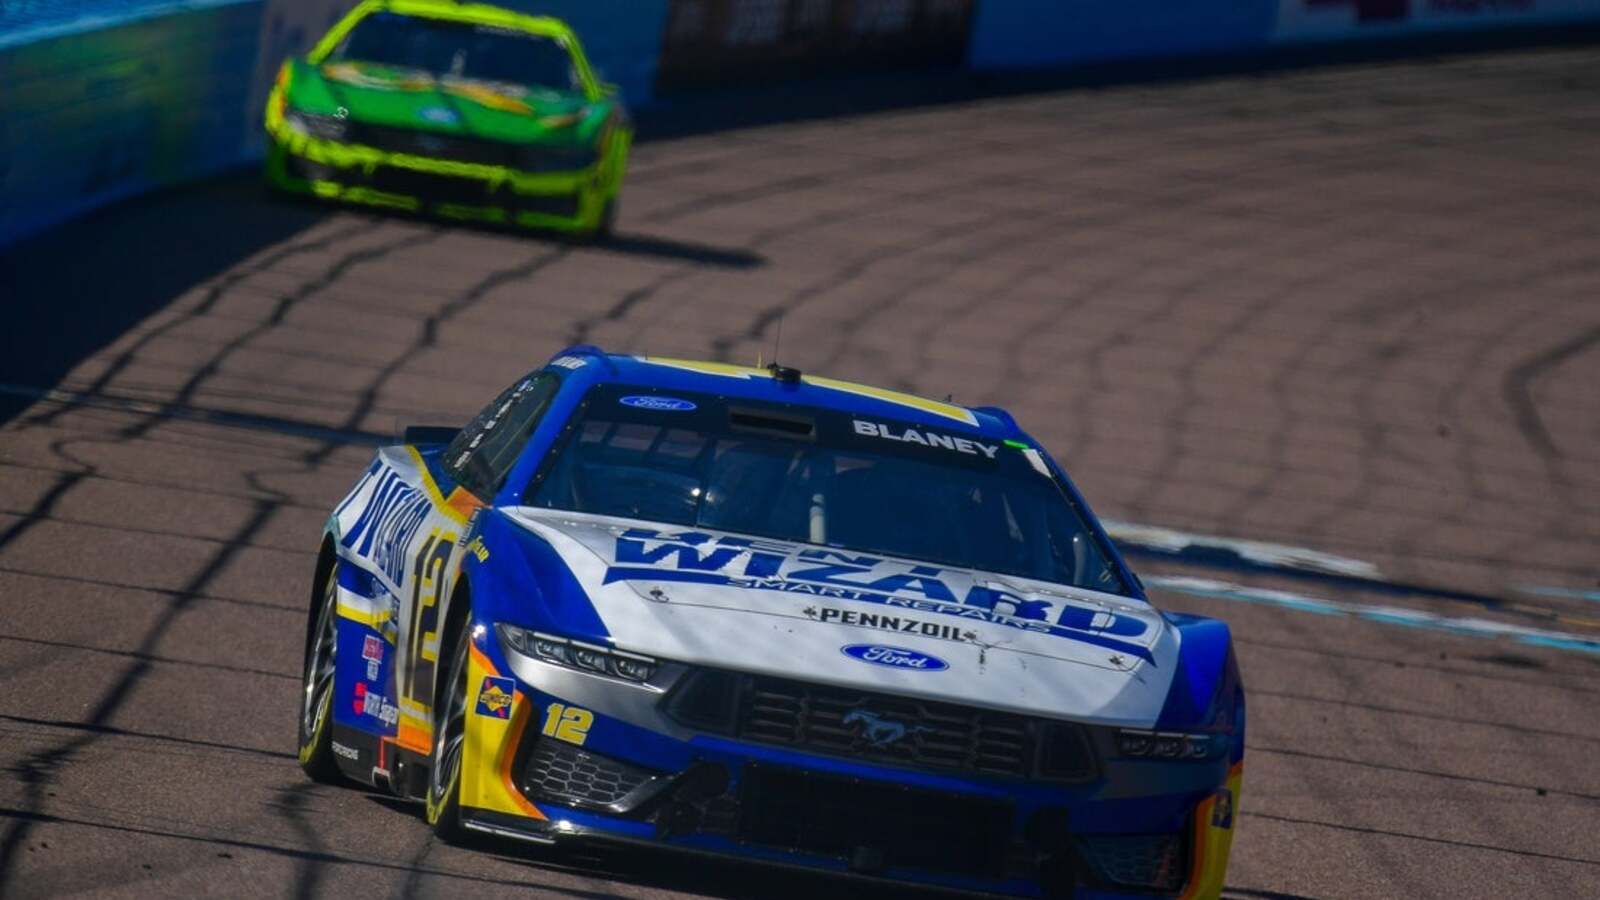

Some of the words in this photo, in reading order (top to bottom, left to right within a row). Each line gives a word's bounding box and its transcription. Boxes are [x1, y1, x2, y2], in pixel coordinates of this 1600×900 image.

[853, 419, 998, 459] BLANEY
[615, 537, 1148, 637] WIZARD
[726, 578, 865, 603] SMART
[885, 596, 1050, 633] REPAIRS
[820, 607, 966, 642] PENNZOIL
[860, 644, 929, 669] Ford
[542, 702, 594, 747] 12
